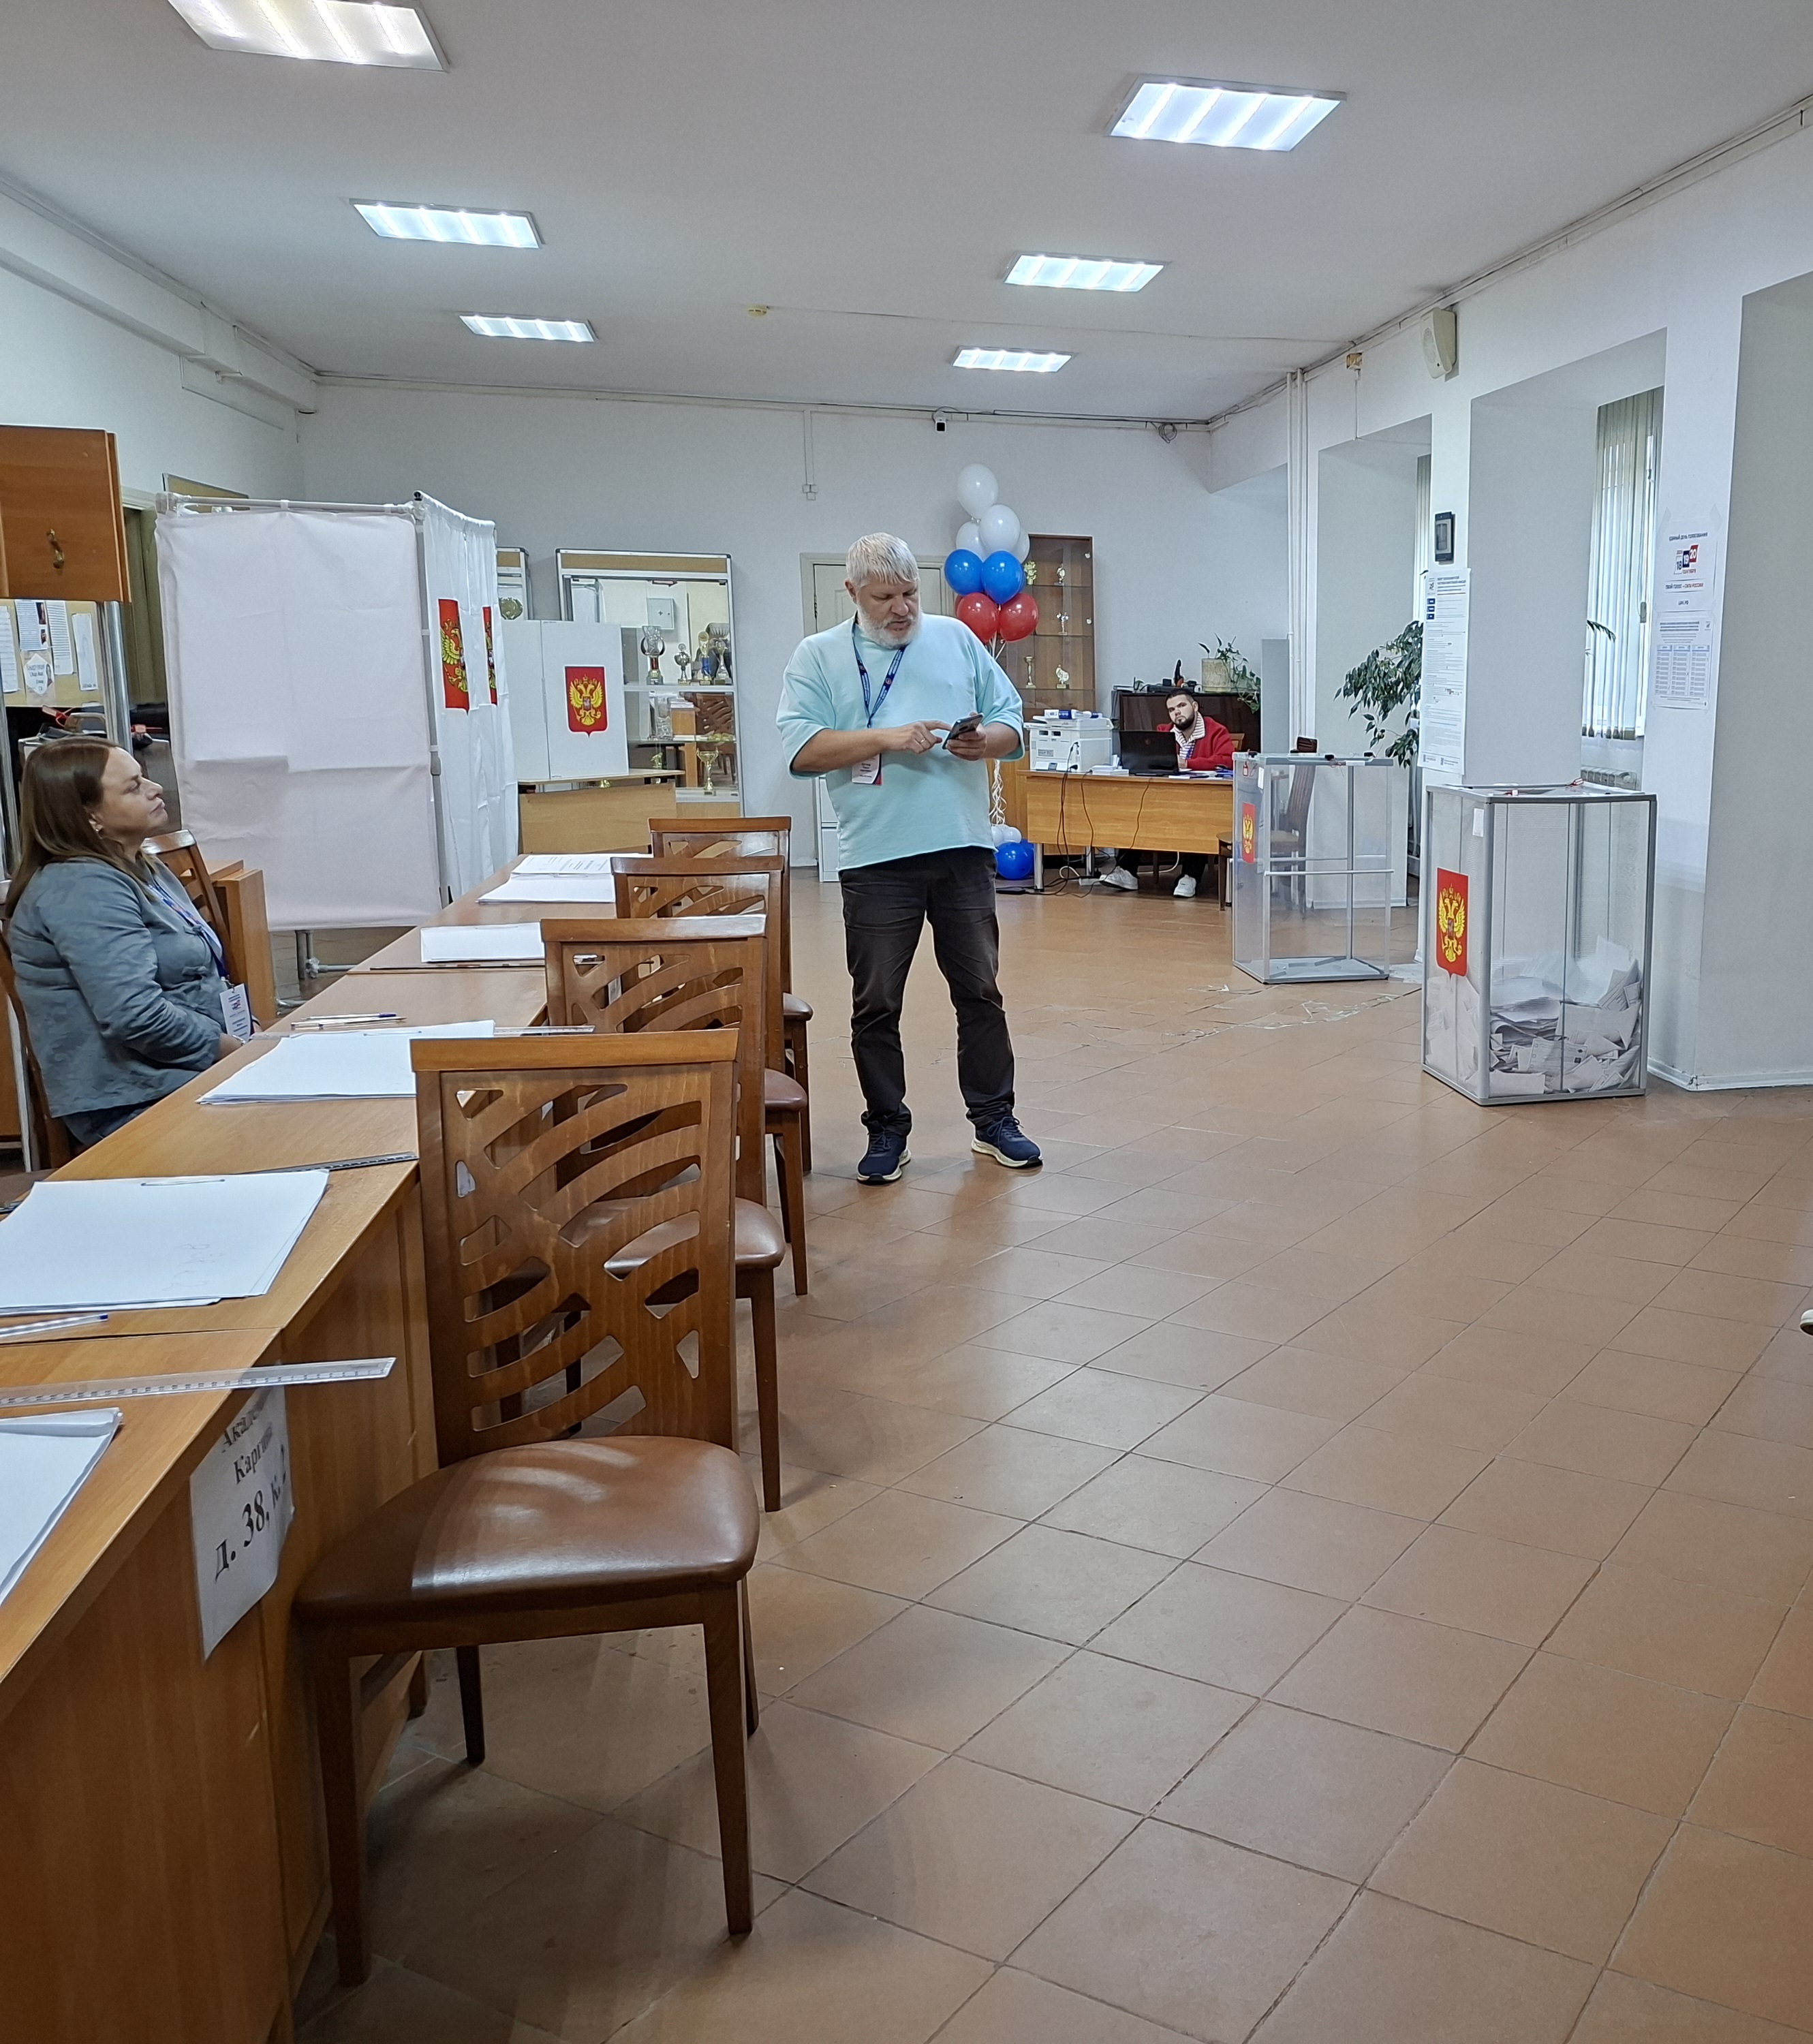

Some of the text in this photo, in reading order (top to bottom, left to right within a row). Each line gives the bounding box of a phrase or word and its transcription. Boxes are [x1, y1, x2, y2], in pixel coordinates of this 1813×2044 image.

[1677, 561, 1682, 570] 18
[1684, 554, 1689, 565] 19
[1690, 549, 1696, 559] 20
[241, 1489, 270, 1548] 38,
